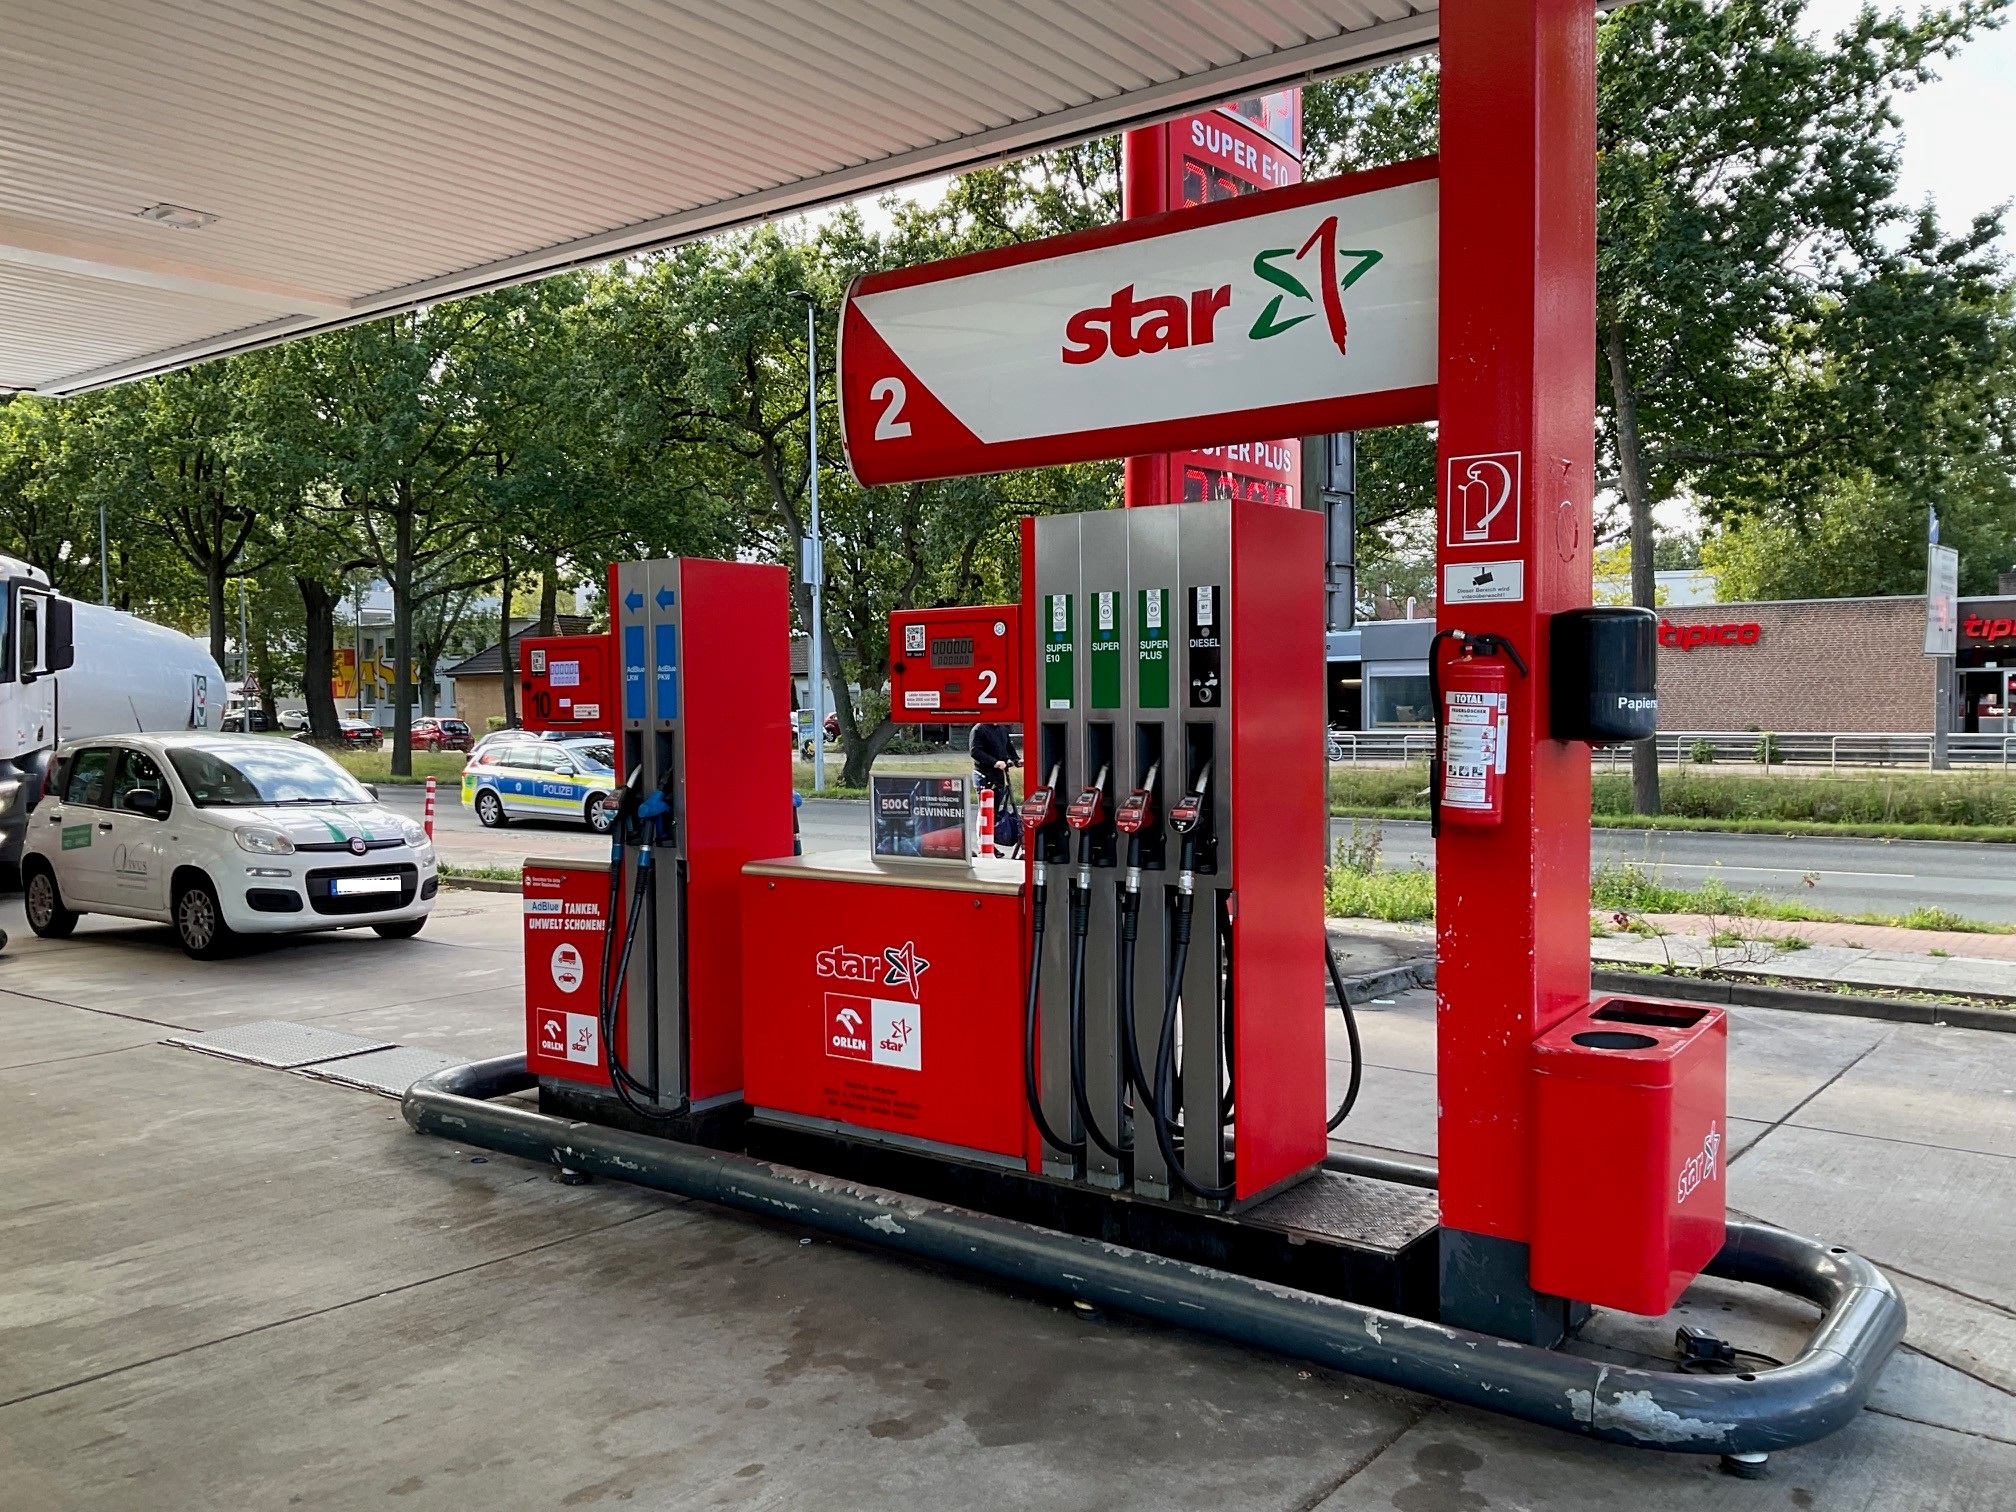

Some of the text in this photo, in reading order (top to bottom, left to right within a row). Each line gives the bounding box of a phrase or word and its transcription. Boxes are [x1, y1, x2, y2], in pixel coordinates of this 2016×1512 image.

[1191, 119, 1257, 173] SUPER
[1262, 154, 1288, 186] E10
[1062, 283, 1231, 365] star
[870, 377, 912, 441] 2
[1255, 442, 1291, 472] PLUS
[1658, 619, 1761, 651] tipico
[1046, 643, 1073, 653] SUPER
[1092, 641, 1119, 651] SUPER
[1140, 640, 1168, 649] SUPER
[1189, 638, 1220, 648] DIESEL
[1046, 654, 1060, 663] E10
[1140, 651, 1162, 660] PLUS
[978, 670, 998, 704] 2
[532, 691, 550, 718] 10
[1455, 694, 1483, 704] TOTAL
[543, 785, 573, 796] POLIZEI
[913, 806, 965, 818] GEWINNEN!
[532, 902, 600, 916] AdBlue TANKEN,
[529, 918, 605, 931] UMWELT SCHONEN!
[816, 945, 881, 982] star
[542, 1040, 564, 1051] ORLEN
[572, 1042, 587, 1052] star
[832, 1035, 866, 1051] ORLEN
[880, 1038, 903, 1052] star
[1678, 1152, 1704, 1203] star
